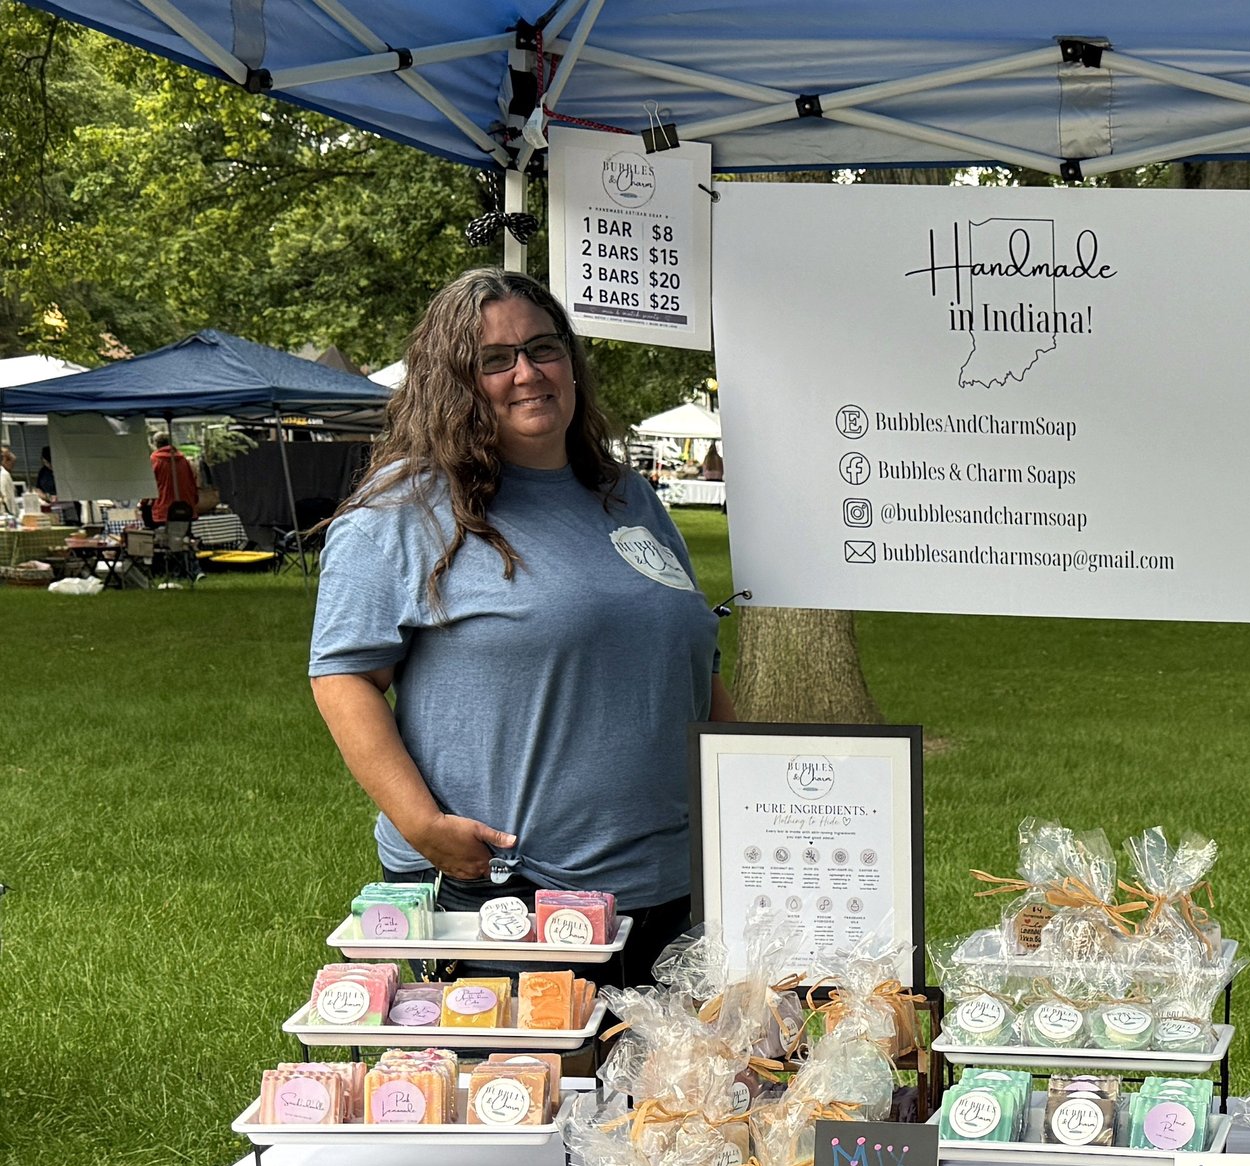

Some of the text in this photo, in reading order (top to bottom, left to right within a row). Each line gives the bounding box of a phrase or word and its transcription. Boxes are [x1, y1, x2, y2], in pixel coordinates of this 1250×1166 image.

[603, 161, 655, 177] BUBBLES
[583, 216, 674, 242] 1 BAR $8
[581, 240, 678, 266] 2 BARS $15
[905, 222, 1118, 304] Handmade
[582, 263, 680, 289] 3 BARS $20
[582, 286, 680, 312] 4 BARS $25
[948, 302, 1093, 335] in Indiana!
[875, 412, 1077, 441] BubblesAndCharmSoap
[878, 460, 1076, 488] Bubbles & Charm Soaps
[880, 502, 1088, 531] @bubblesandcharmsoap
[882, 544, 1175, 573] bubblesandcharmsoap@gmail.com
[756, 803, 868, 816] PURE INGREDIENTS.
[387, 1090, 411, 1107] Pink
